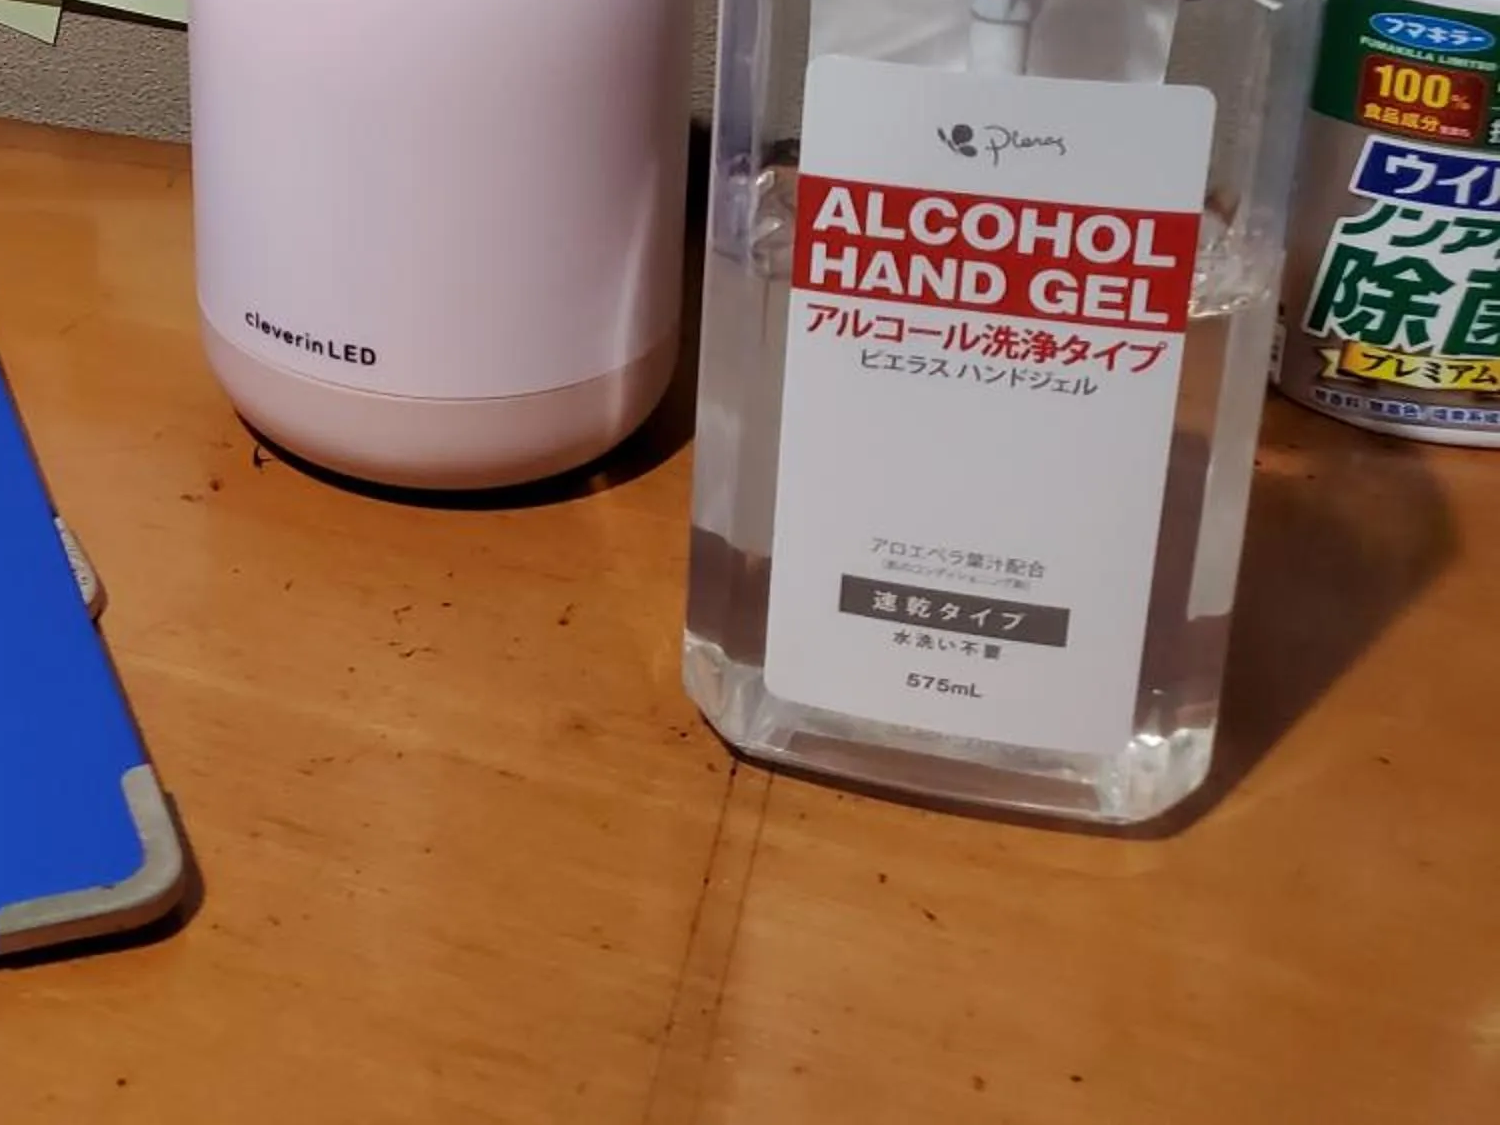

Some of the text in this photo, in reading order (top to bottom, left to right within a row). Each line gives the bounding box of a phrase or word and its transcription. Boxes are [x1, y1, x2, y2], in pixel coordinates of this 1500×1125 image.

[1383, 17, 1486, 46] フマキラー
[812, 185, 1177, 268] ALCOHOL
[808, 241, 1169, 323] HAND GEL
[245, 311, 377, 367] cleverin LED
[805, 303, 1169, 376] アルコール洗浄タイプ
[1359, 352, 1499, 385] プレミアム
[871, 589, 1028, 631] 速乾タイプ
[905, 672, 984, 699] 575mL
